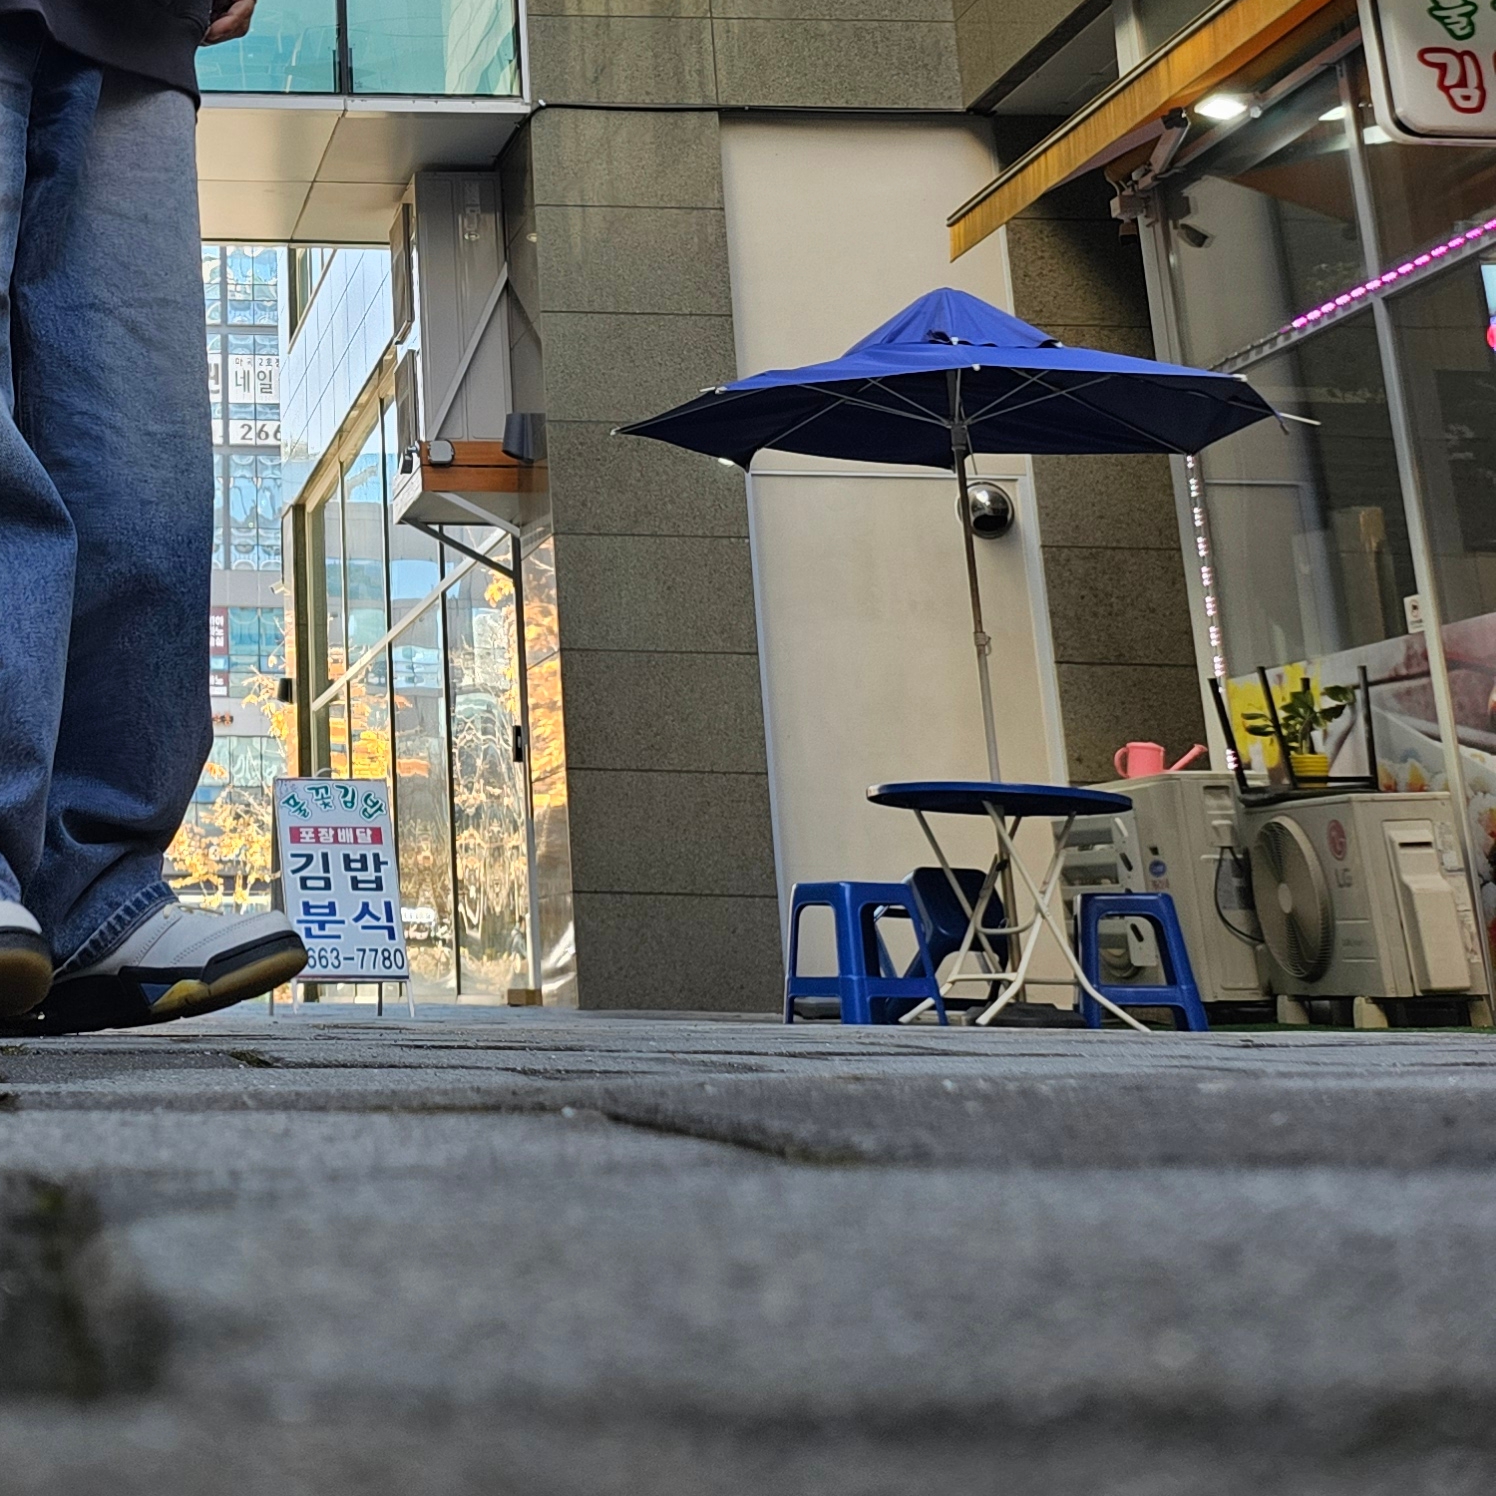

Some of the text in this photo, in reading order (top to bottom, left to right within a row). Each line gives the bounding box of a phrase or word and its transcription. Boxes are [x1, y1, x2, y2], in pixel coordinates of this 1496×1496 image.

[1417, 46, 1496, 114] 김
[235, 369, 273, 395] 네일
[299, 827, 372, 843] 포장배달
[290, 852, 388, 892] 김밥
[1334, 867, 1353, 888] LG
[296, 901, 397, 941] 분식
[306, 947, 405, 970] 663-7780
